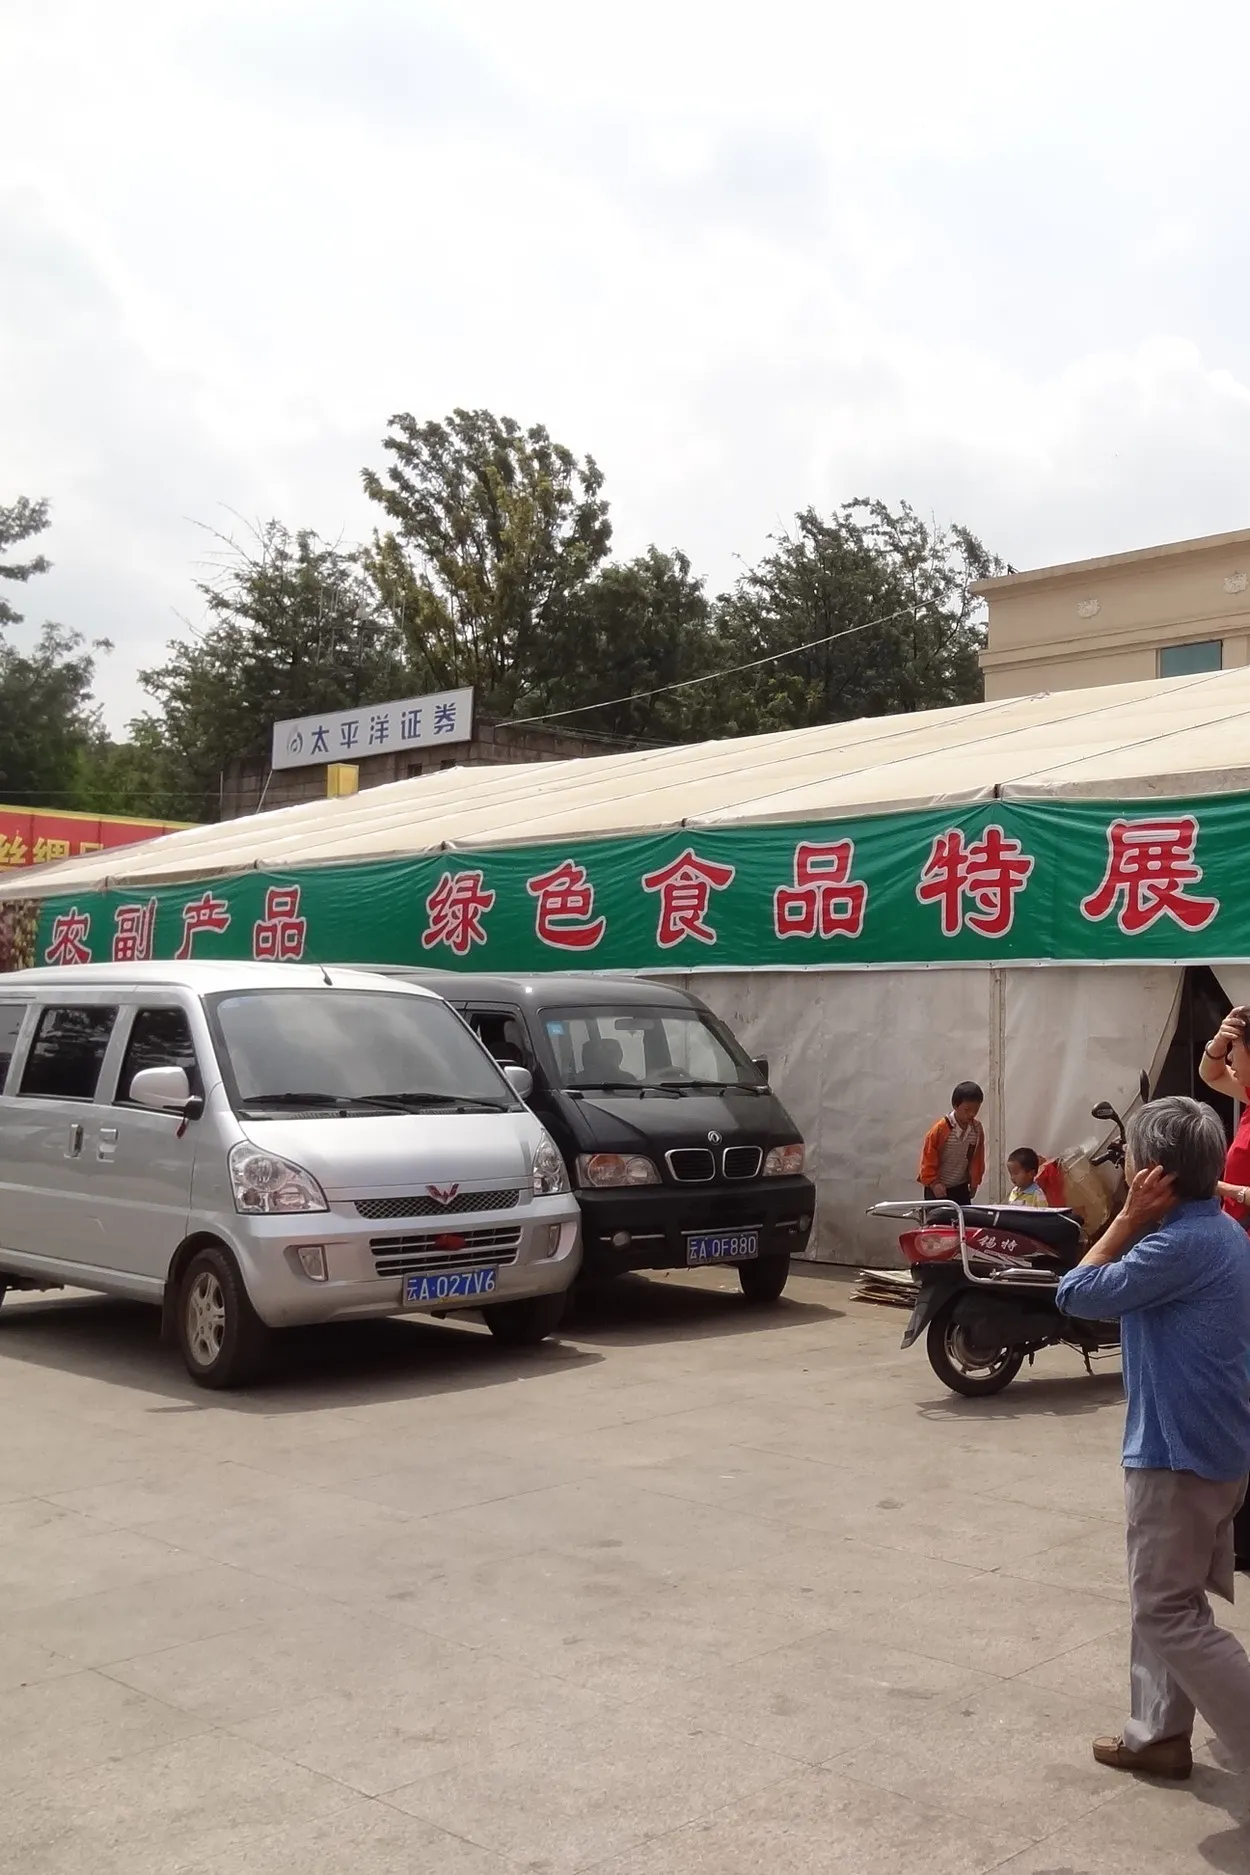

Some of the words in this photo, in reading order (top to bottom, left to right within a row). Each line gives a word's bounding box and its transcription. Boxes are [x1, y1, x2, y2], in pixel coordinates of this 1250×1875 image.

[311, 702, 456, 755] 太平洋证券
[44, 884, 307, 966] 农副产品
